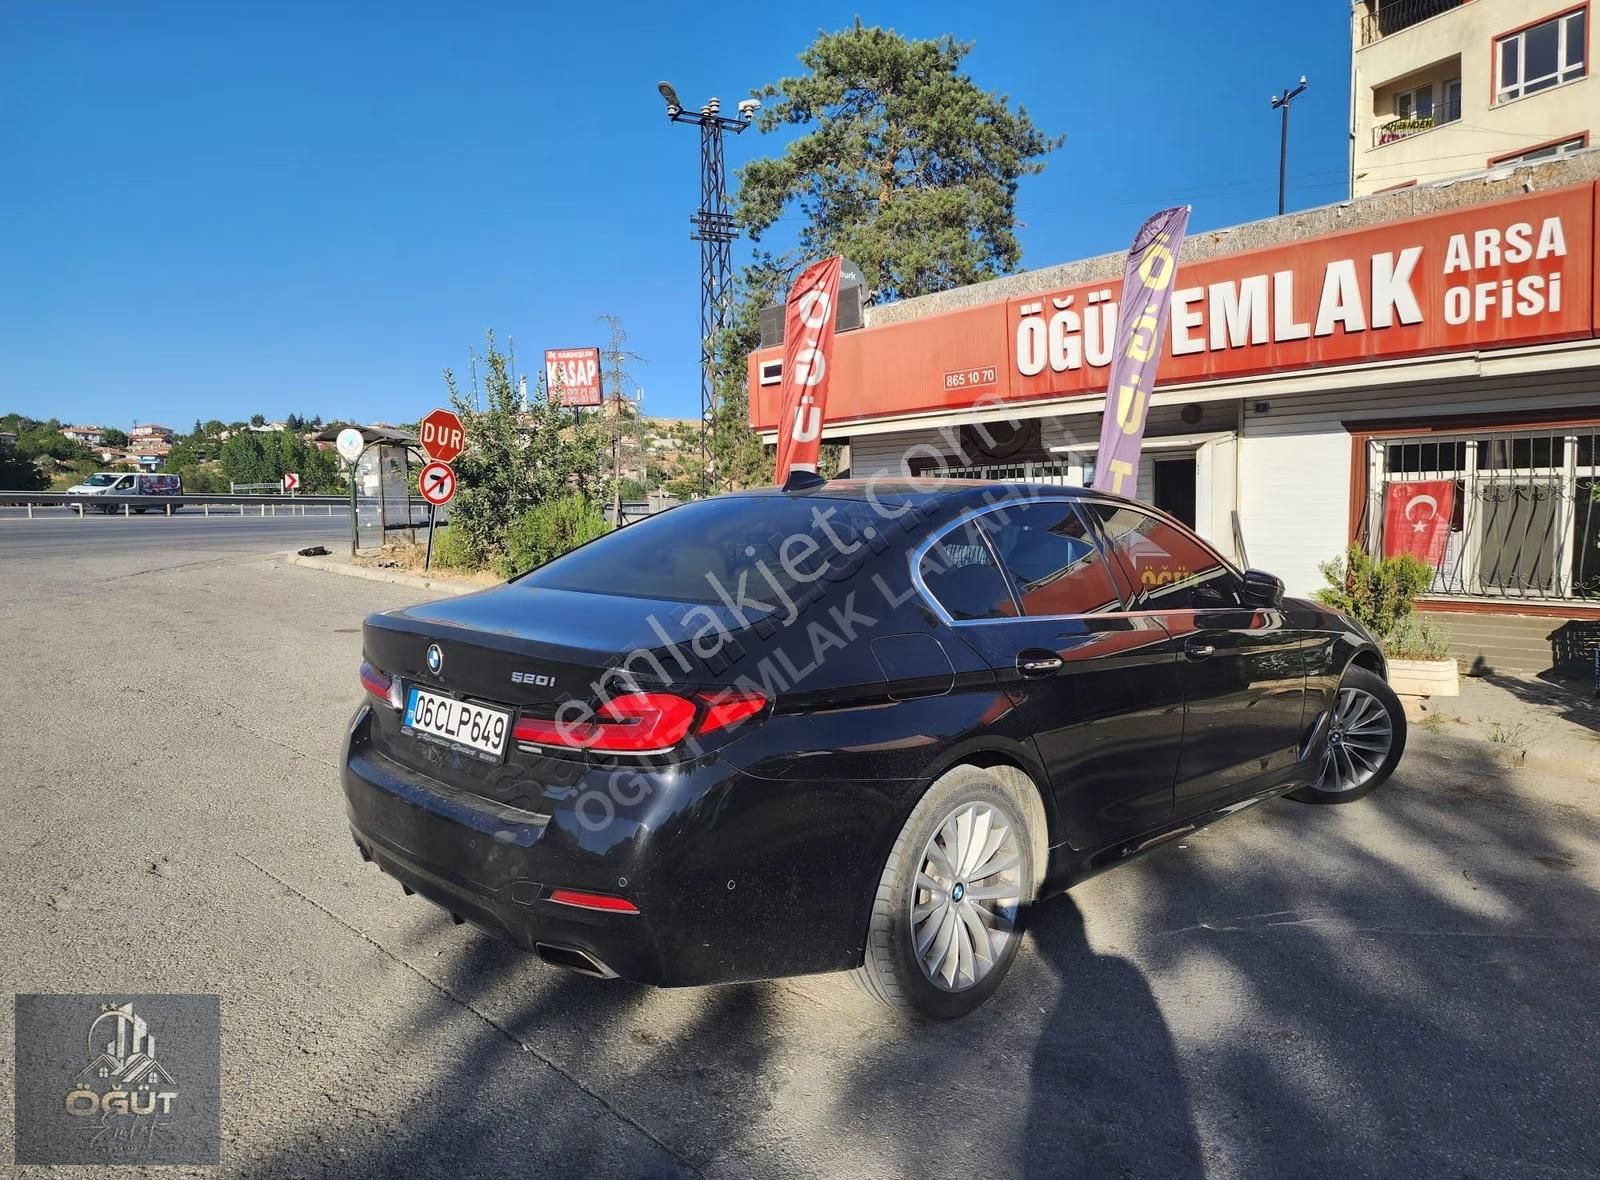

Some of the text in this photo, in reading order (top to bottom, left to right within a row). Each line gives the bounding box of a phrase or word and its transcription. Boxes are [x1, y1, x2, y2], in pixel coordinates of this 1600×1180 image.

[1443, 216, 1568, 274] ARSA
[1016, 245, 1425, 377] ÖĞÜ EMLAK
[546, 358, 597, 388] KASAP
[790, 280, 832, 474] ÖĞÜ
[946, 369, 995, 387] 865 10 70
[423, 422, 462, 450] DUR
[415, 695, 504, 750] 06CLP649
